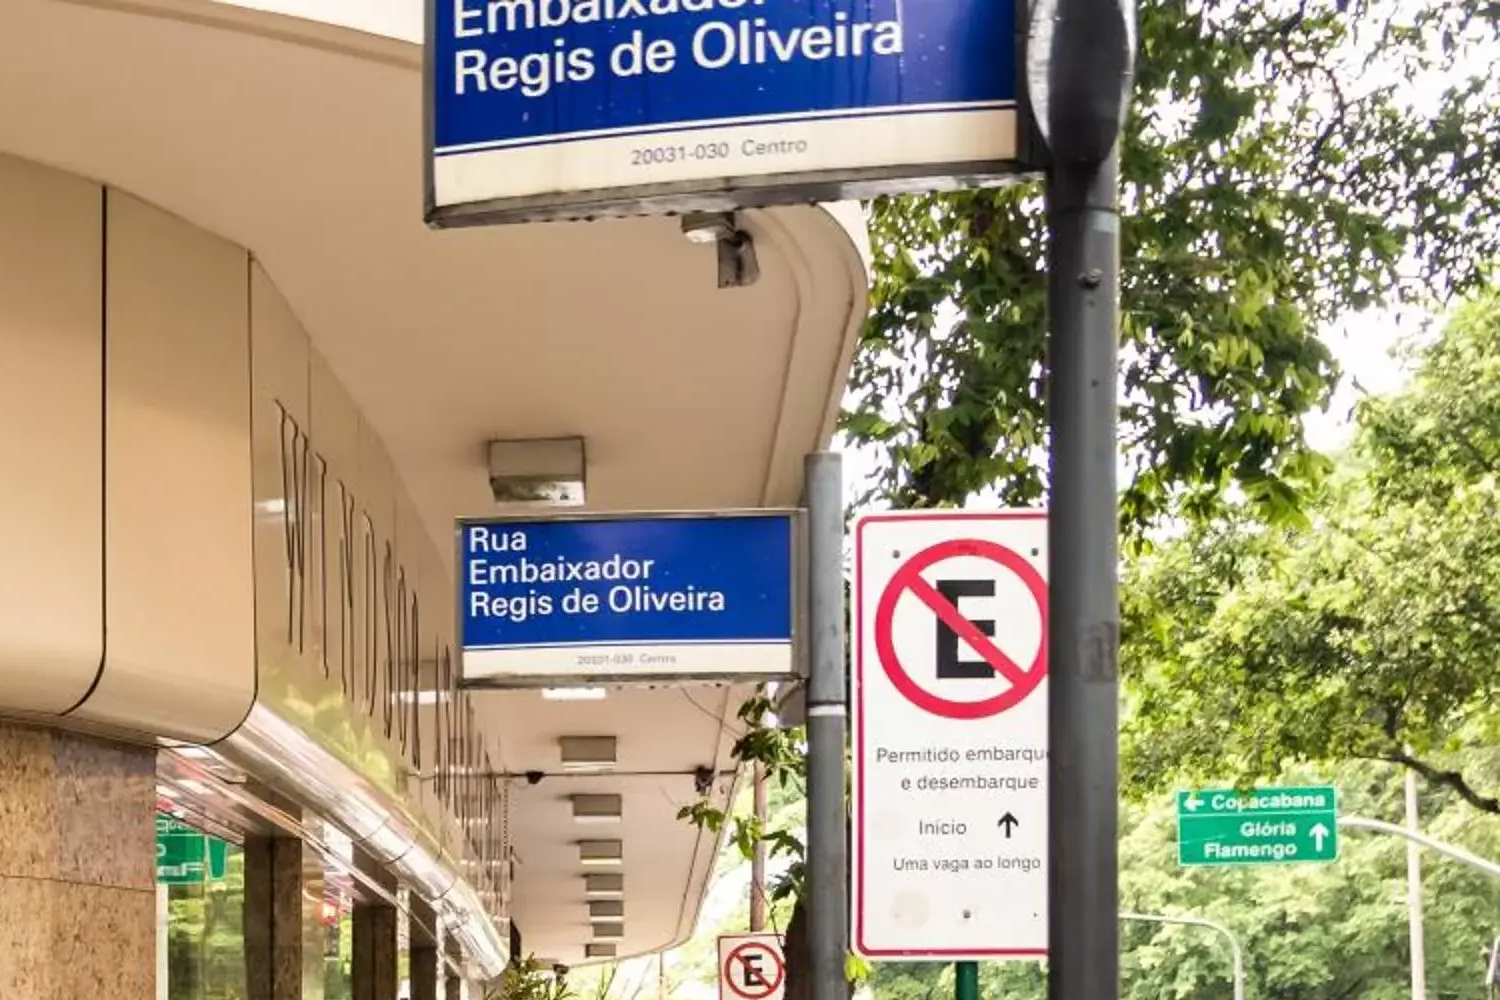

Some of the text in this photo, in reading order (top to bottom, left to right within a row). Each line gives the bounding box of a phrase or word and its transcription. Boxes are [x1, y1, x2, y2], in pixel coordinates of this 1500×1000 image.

[453, 0, 764, 38] Embax
[455, 12, 903, 97] Regis de Oliveira
[630, 139, 808, 166] 20031-030 Centro
[469, 526, 527, 552] Rua
[469, 554, 655, 585] Embaixador
[470, 585, 725, 621] Regis de Oliveira
[936, 579, 996, 679] E
[876, 746, 1050, 764] Permitido embarqu
[900, 775, 1039, 791] e desembarque
[1211, 793, 1326, 812] Copacabana
[1240, 821, 1297, 837] Glória
[1204, 842, 1297, 859] Flamengo
[893, 856, 1041, 873] Uma vaga ao longo
